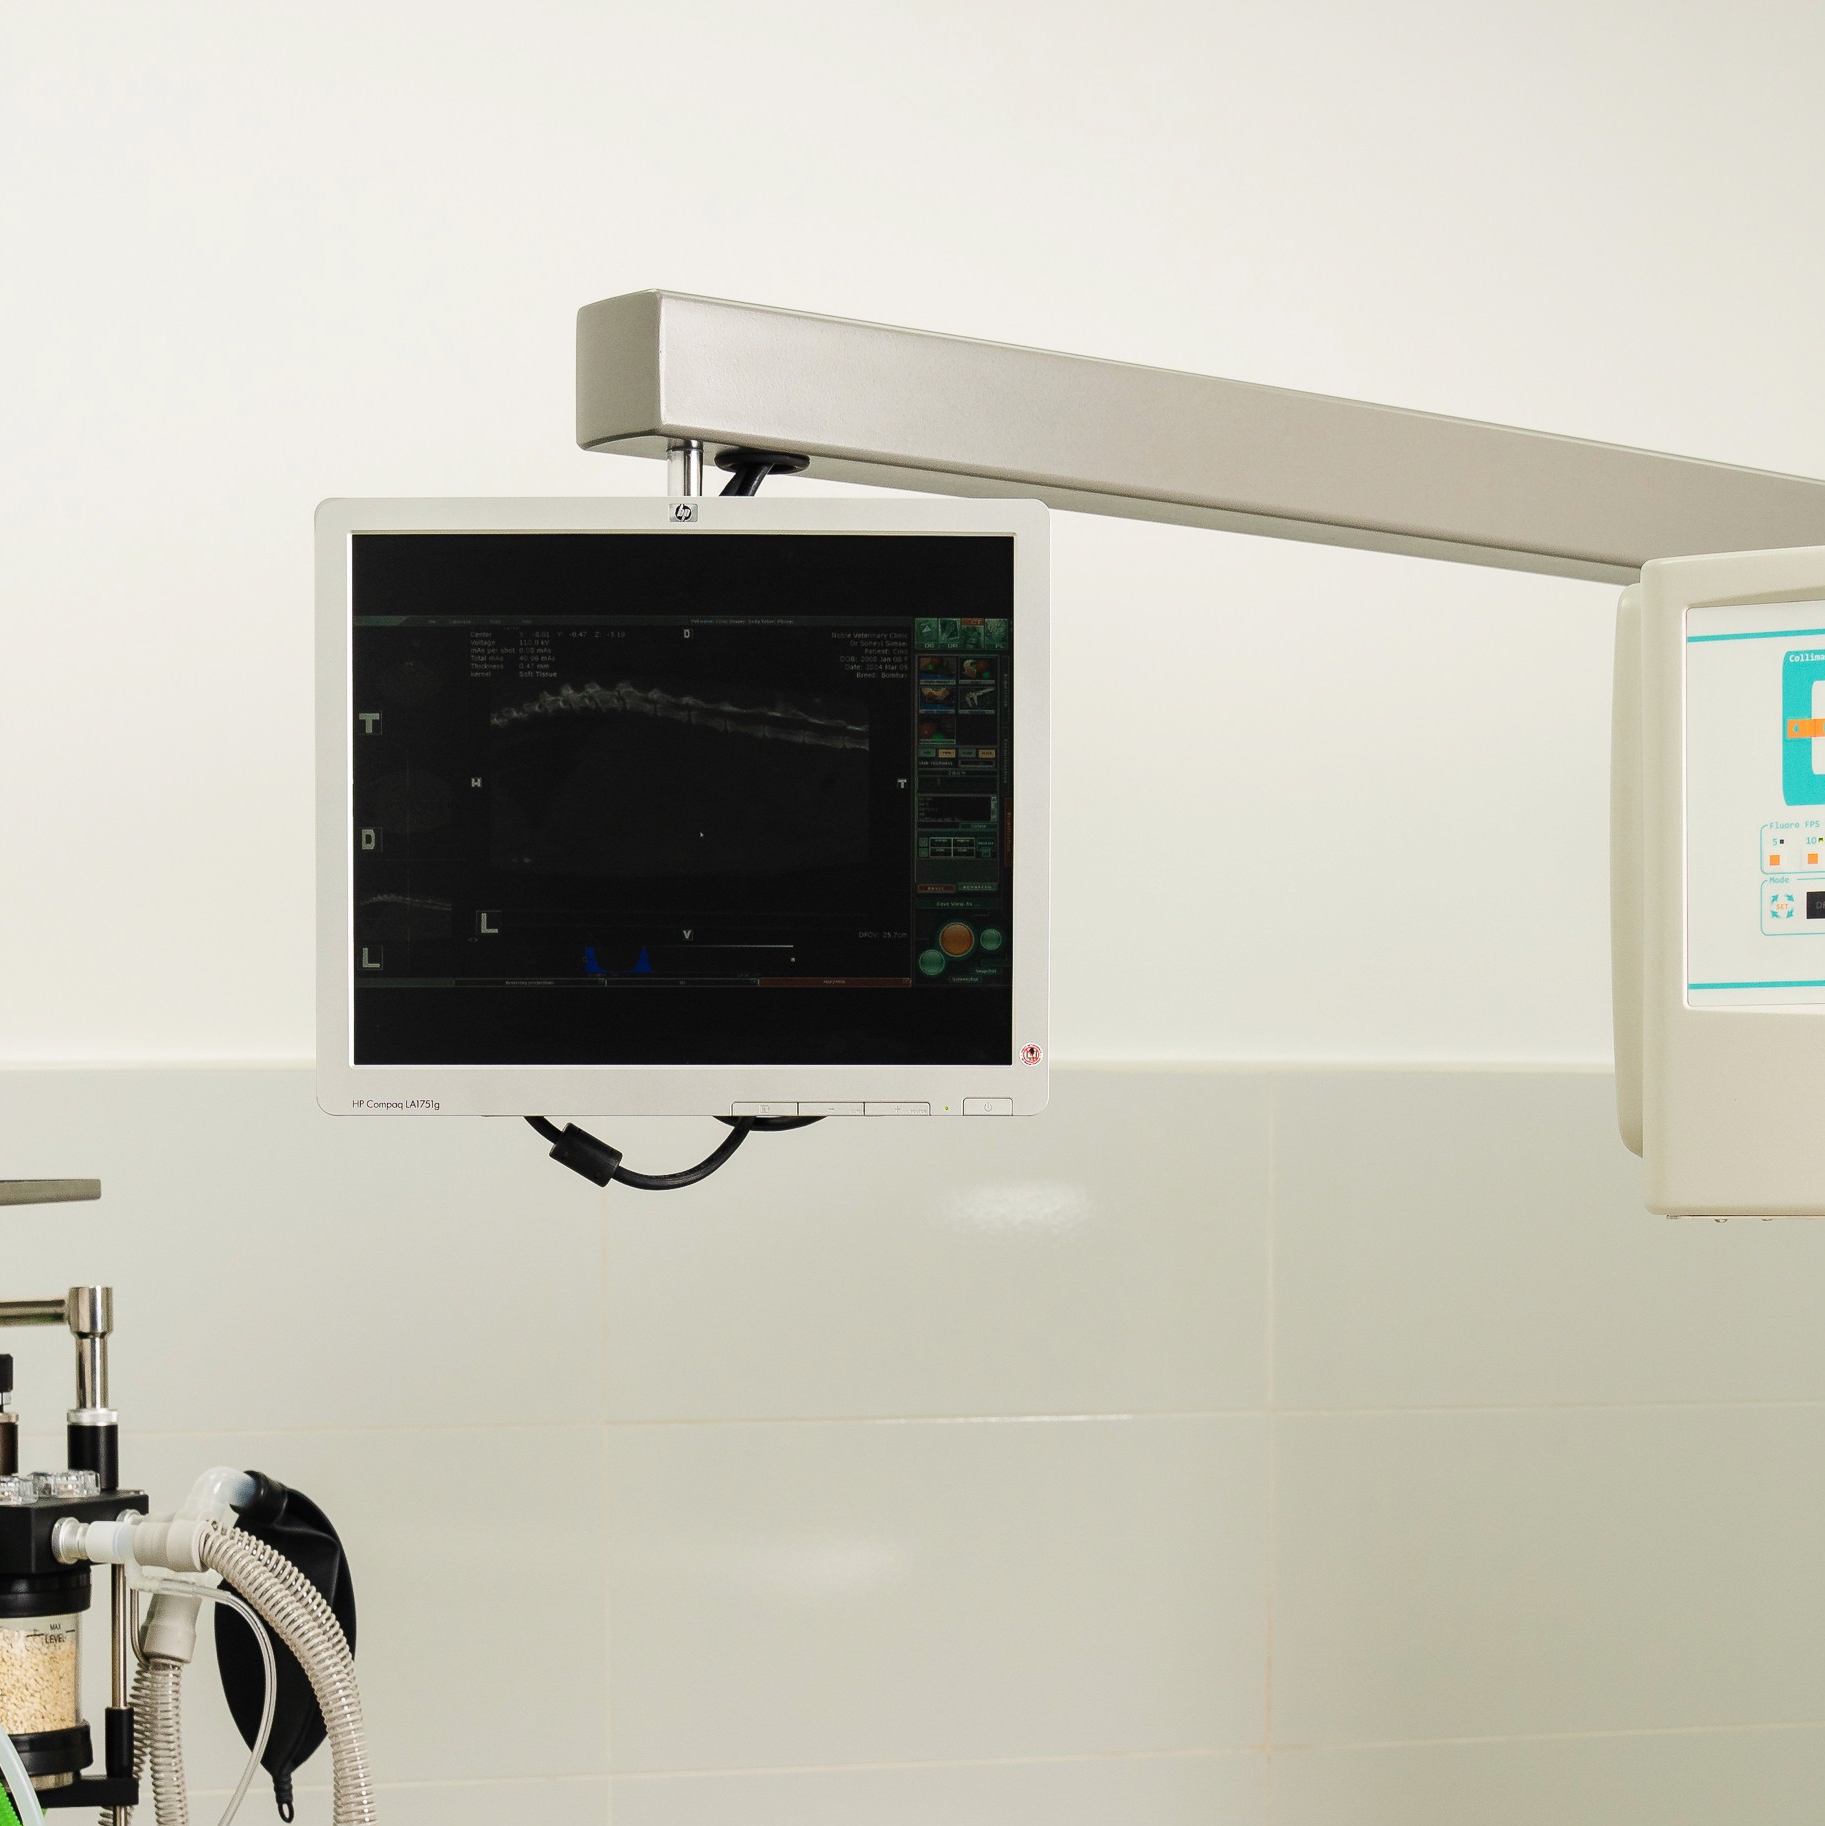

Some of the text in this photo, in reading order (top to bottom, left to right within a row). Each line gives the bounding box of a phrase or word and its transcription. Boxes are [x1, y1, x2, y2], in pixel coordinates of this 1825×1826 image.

[683, 629, 690, 639] D
[358, 712, 380, 734] T
[1770, 820, 1820, 830] Fluoro FPS
[361, 828, 375, 850] D
[1772, 838, 1778, 846] 5
[1806, 837, 1817, 845] 10
[1769, 876, 1790, 884] Mode
[480, 912, 499, 934] L
[682, 929, 692, 939] V
[362, 947, 380, 968] L
[352, 1100, 440, 1110] HP Compaq LA1751g
